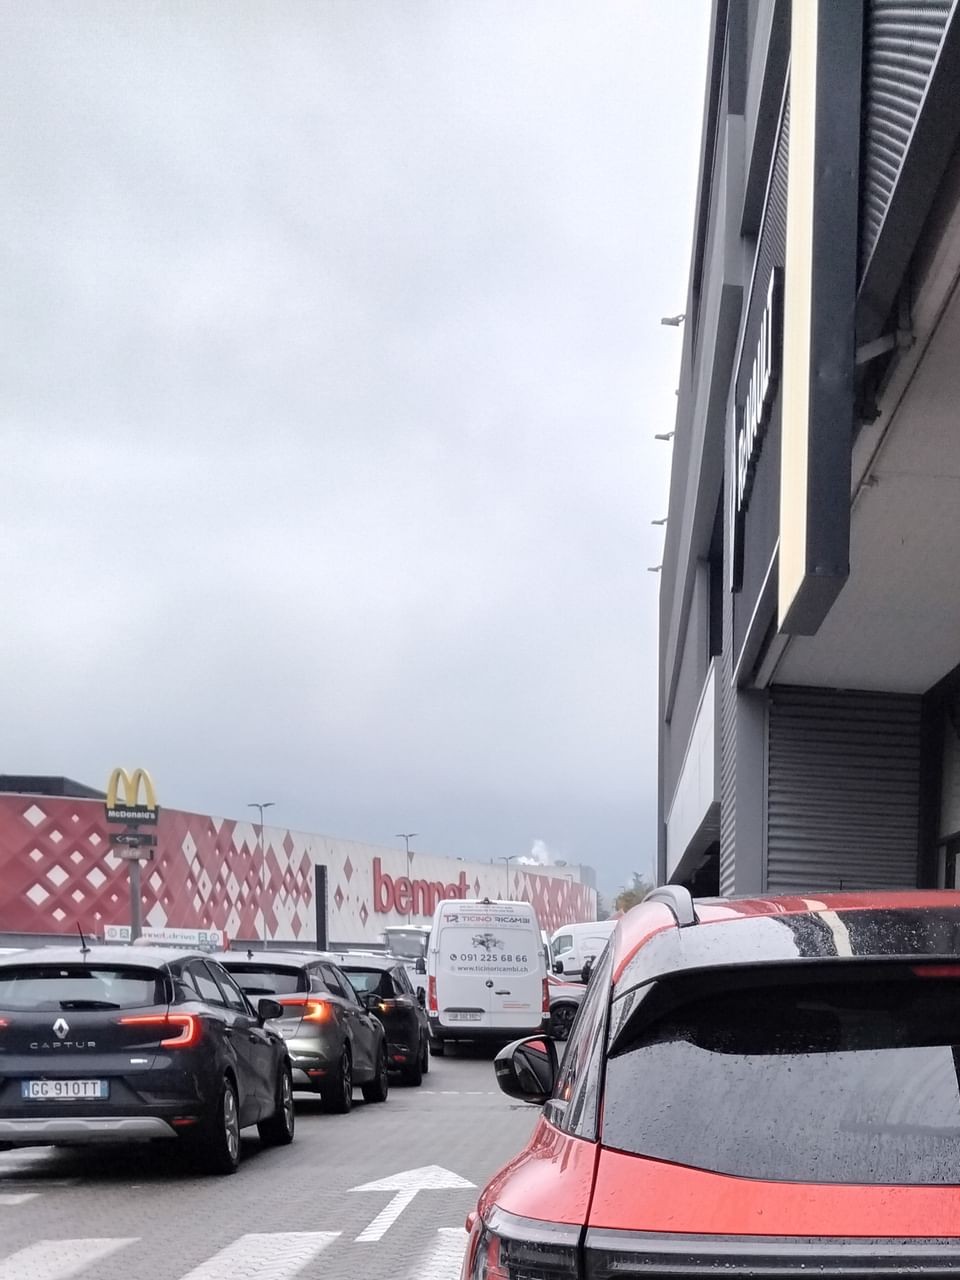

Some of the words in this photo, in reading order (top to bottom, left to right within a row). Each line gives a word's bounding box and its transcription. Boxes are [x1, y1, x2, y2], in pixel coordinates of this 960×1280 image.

[737, 265, 775, 511] RENAULT
[108, 810, 156, 820] McDonald's
[462, 915, 492, 923] TICINO
[494, 916, 531, 924] RICAMBI
[460, 953, 477, 962] 091
[480, 953, 498, 962] 225
[501, 954, 513, 963] 68
[515, 954, 528, 963] 66
[457, 964, 529, 973] www.ticinoricambi.ch
[30, 1041, 97, 1049] CAPTUR
[31, 1082, 49, 1096] GG
[54, 1081, 99, 1095] 910TT
